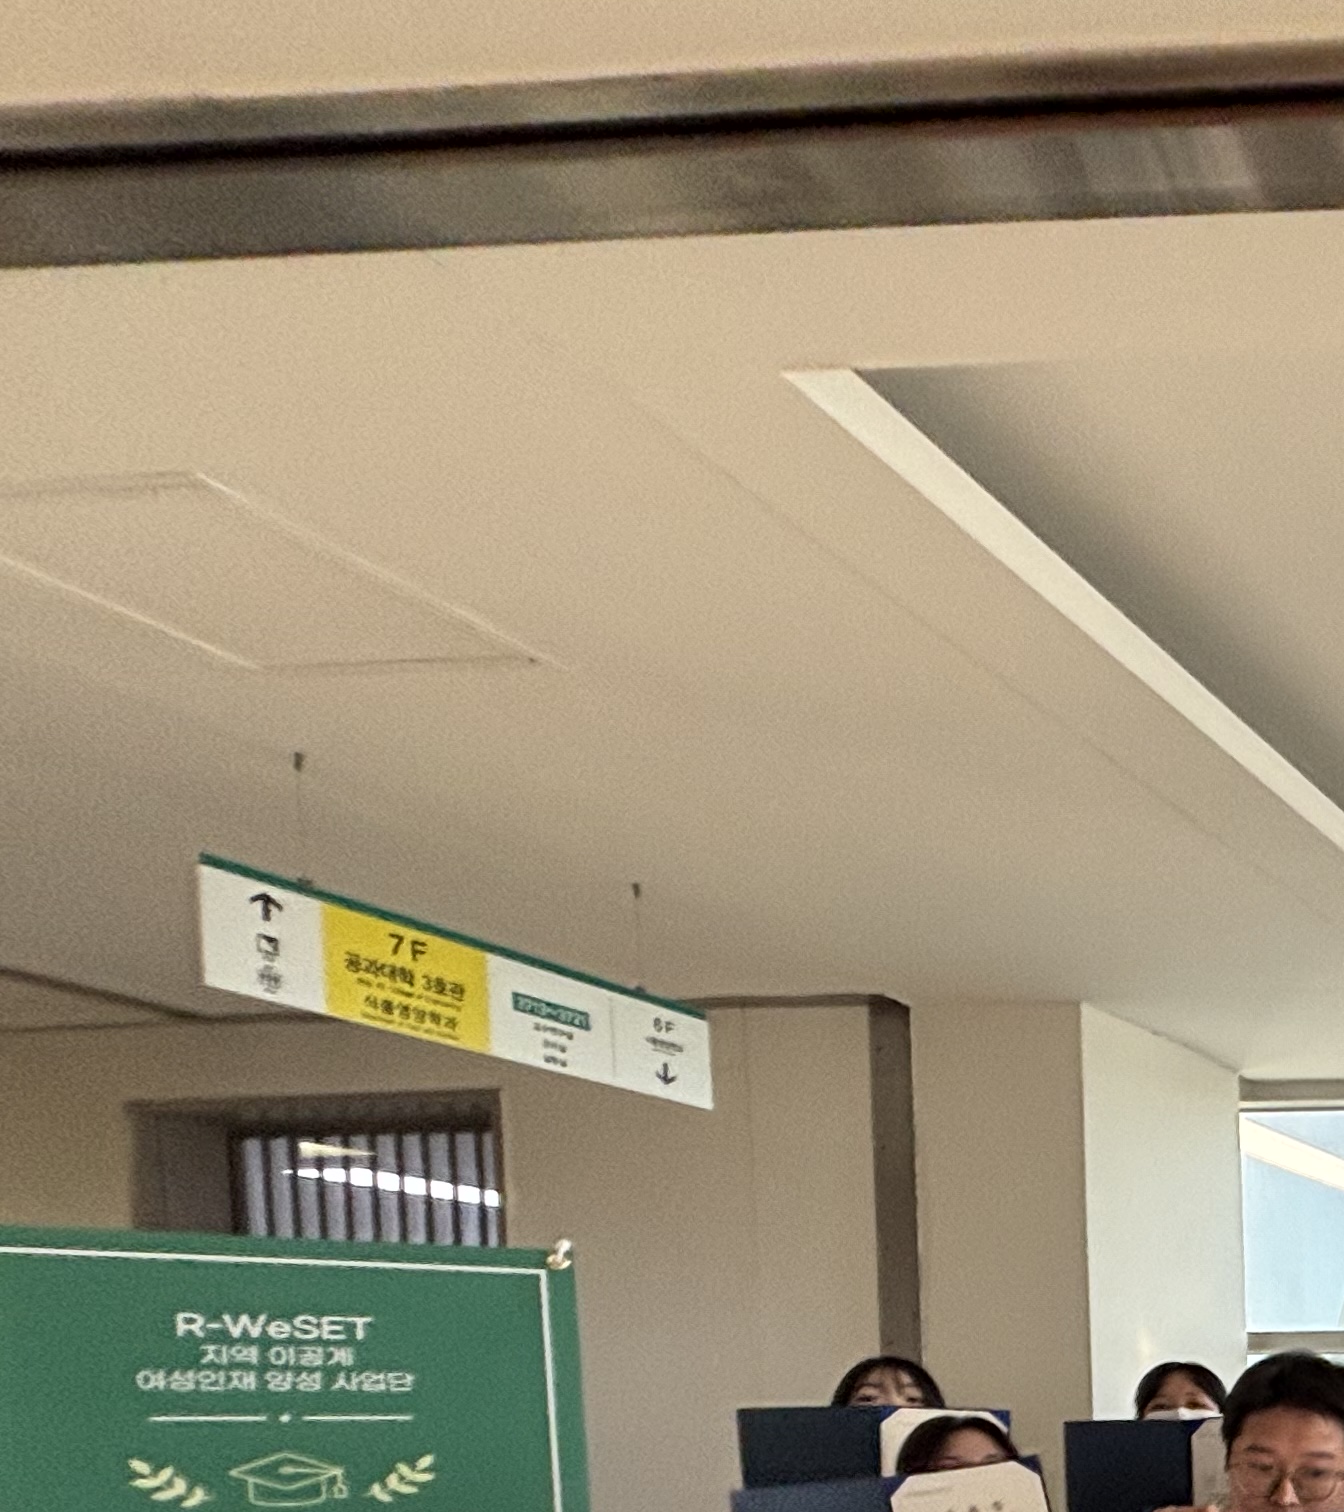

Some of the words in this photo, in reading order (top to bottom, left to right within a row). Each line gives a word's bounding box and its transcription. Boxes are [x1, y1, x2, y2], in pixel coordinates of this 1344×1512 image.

[388, 932, 428, 962] 7F
[175, 1311, 373, 1342] R-WeSET
[200, 1345, 258, 1368] 지역
[269, 1345, 355, 1368] 이공계
[135, 1370, 256, 1394] 여성인재
[266, 1370, 322, 1394] 양성
[331, 1370, 415, 1394] 사업단
